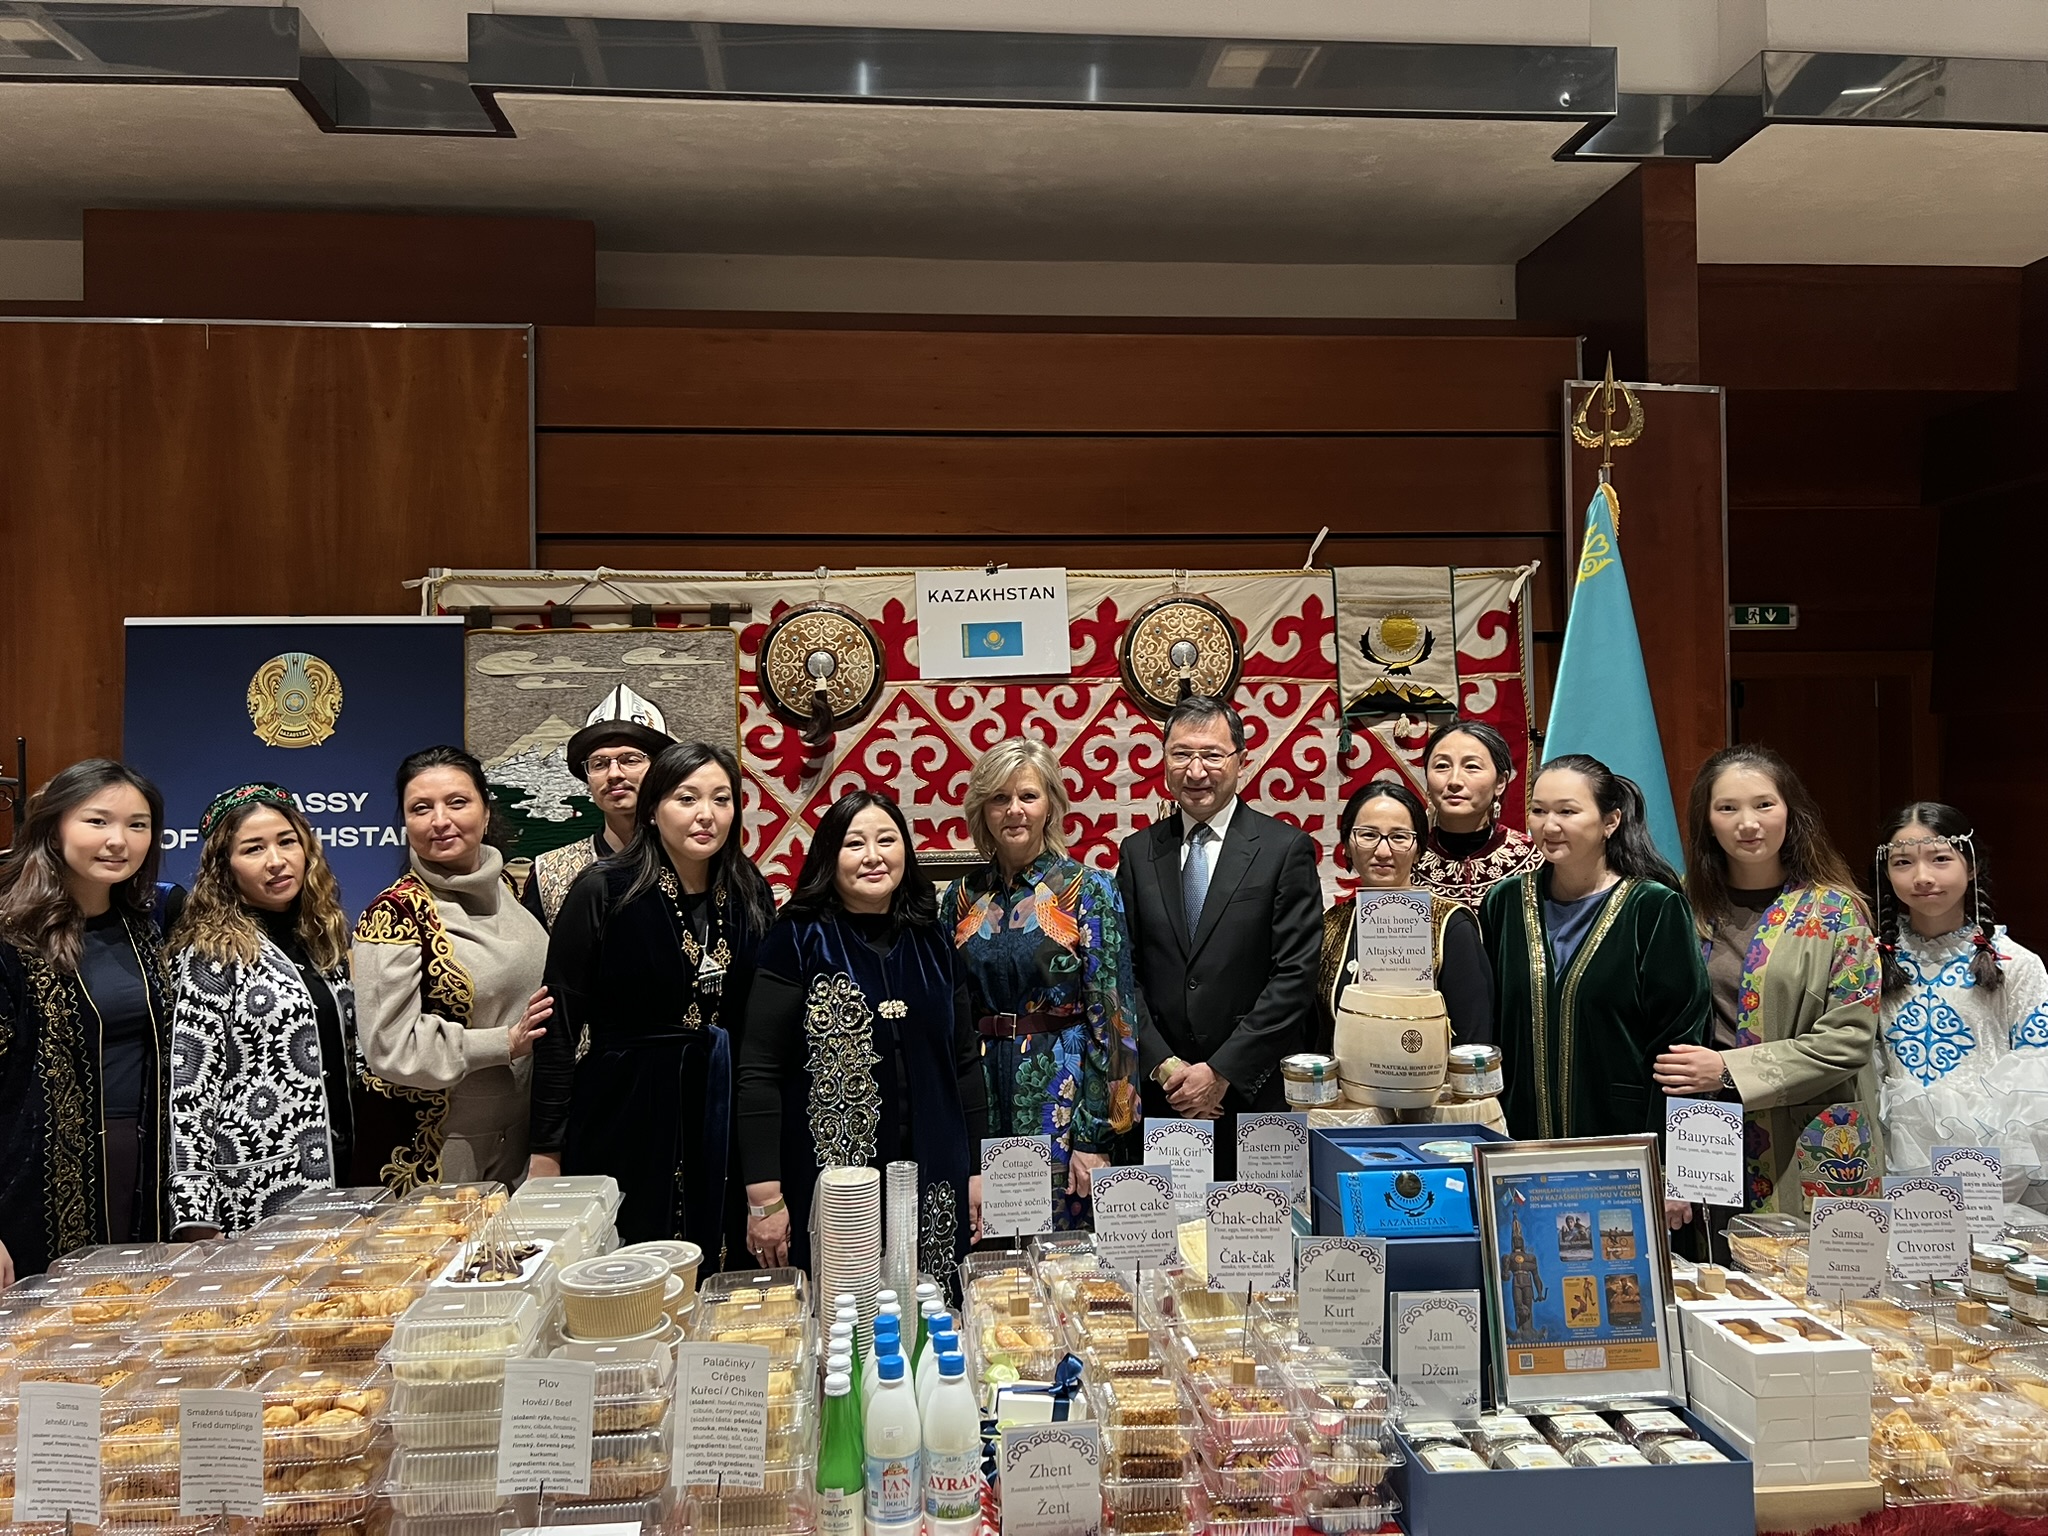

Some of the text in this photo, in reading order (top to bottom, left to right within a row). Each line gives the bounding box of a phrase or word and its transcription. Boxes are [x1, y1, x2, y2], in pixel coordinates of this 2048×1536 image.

[928, 586, 1055, 603] KAZAKHSTAN
[160, 828, 199, 850] OF
[1369, 916, 1419, 926] Altai honey
[1376, 925, 1413, 934] in barrel
[1365, 946, 1426, 957] Altajský med
[1389, 956, 1411, 965] sudu
[1678, 1129, 1735, 1146] Bauyrsak
[1242, 1141, 1300, 1154] Eastern pie
[1002, 1159, 1033, 1169] Cottage
[1169, 1157, 1190, 1167] cake
[989, 1169, 1048, 1180] cheese pastries
[1238, 1169, 1303, 1181] Východní koláč
[1677, 1165, 1735, 1183] Bauyrsak
[1619, 1189, 1641, 1198] ČESKU
[984, 1197, 1051, 1209] Tvarohové sočníky
[1095, 1198, 1170, 1214] Carrot cake
[1211, 1211, 1283, 1225] Chak-chak
[1893, 1207, 1953, 1220] Khvorost
[1380, 1217, 1447, 1228] KAZAKHSTAN
[1097, 1229, 1174, 1243] Mrkvový dort
[1831, 1227, 1864, 1239] Samsa
[1897, 1240, 1955, 1253] Chvorost
[1219, 1247, 1275, 1264] Čak-čak
[1828, 1260, 1860, 1272] Samsa
[1325, 1269, 1355, 1282] Kurt
[1324, 1304, 1355, 1317] Kurt
[1427, 1329, 1453, 1342] Jam
[703, 1357, 756, 1370] Palačinky /
[1422, 1363, 1459, 1376] Džem
[538, 1378, 560, 1388] Plov
[711, 1371, 746, 1383] Crêpes
[691, 1385, 764, 1398] Kuřecí / Chiken
[56, 1401, 80, 1411] Samsa
[522, 1398, 550, 1406] Hovězí
[555, 1399, 573, 1407] Beef
[186, 1408, 224, 1416] Smažená
[225, 1409, 254, 1418] tušpara
[192, 1421, 254, 1432] Fried dumplings
[1029, 1463, 1072, 1479] Zhent
[928, 1474, 978, 1491] AYRAN
[1037, 1498, 1070, 1515] Žent
